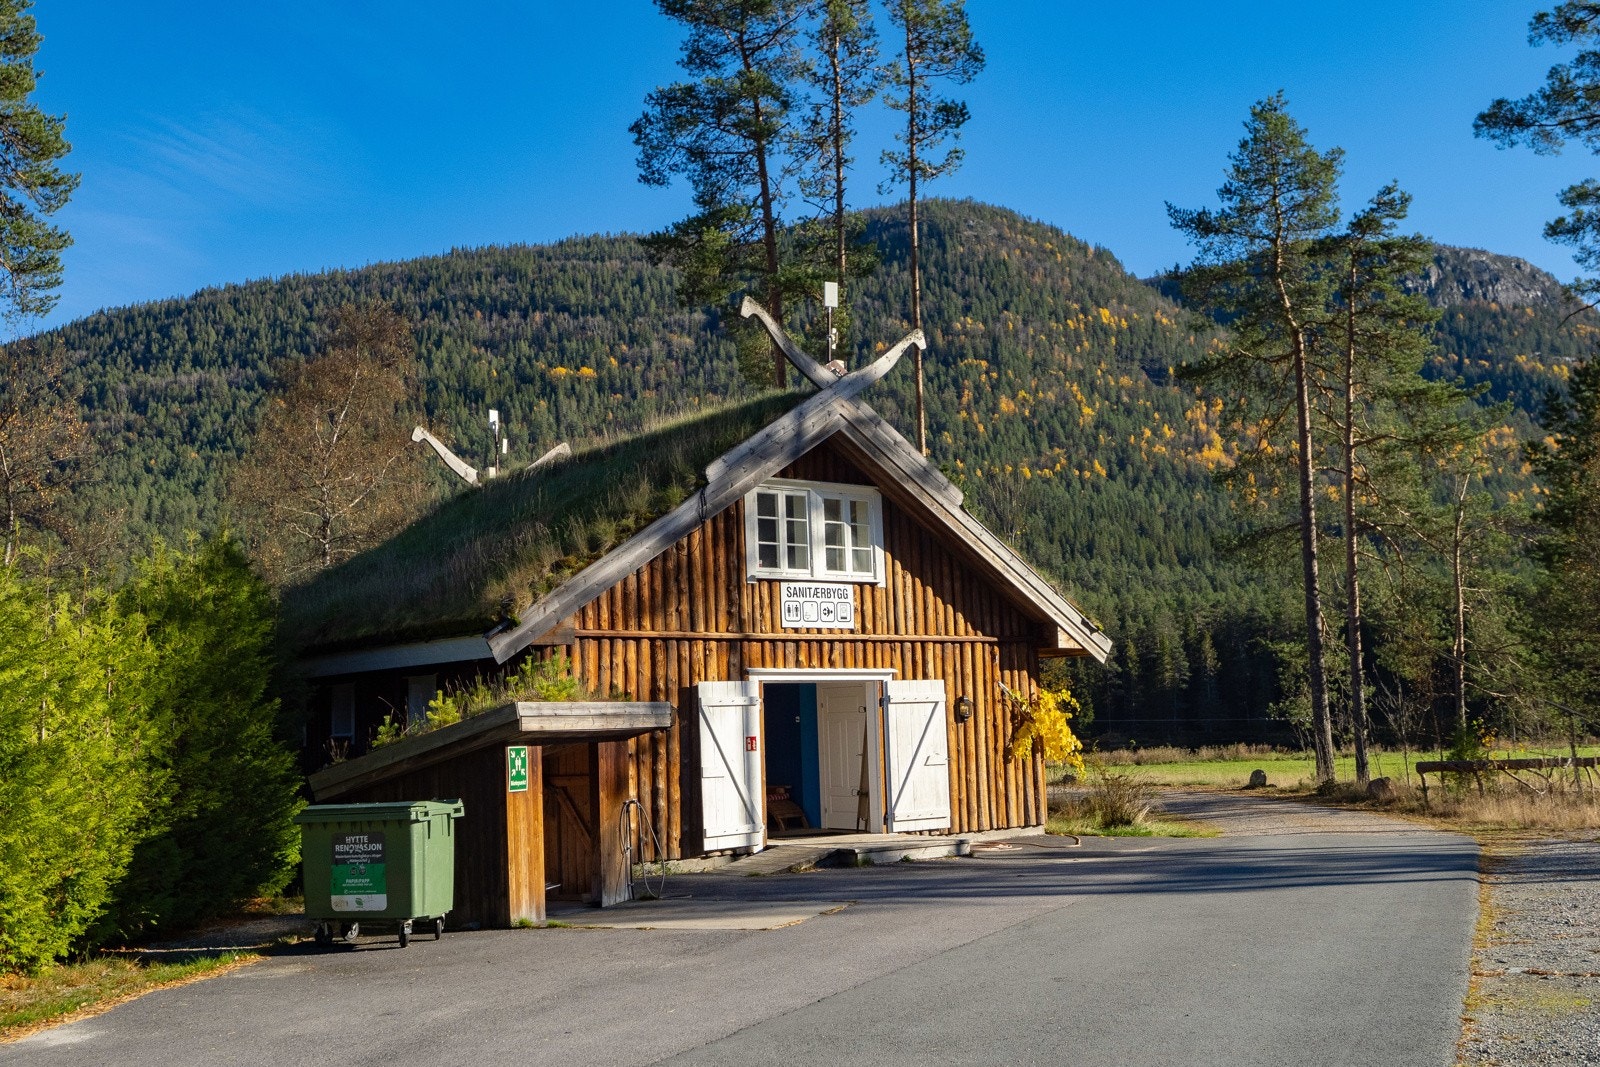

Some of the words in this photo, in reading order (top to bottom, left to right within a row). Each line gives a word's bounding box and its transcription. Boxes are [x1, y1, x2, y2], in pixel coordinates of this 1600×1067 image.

[786, 586, 849, 599] SANITÆRBYGG
[345, 835, 369, 844] HYTTE
[335, 843, 382, 852] RENOVASJON
